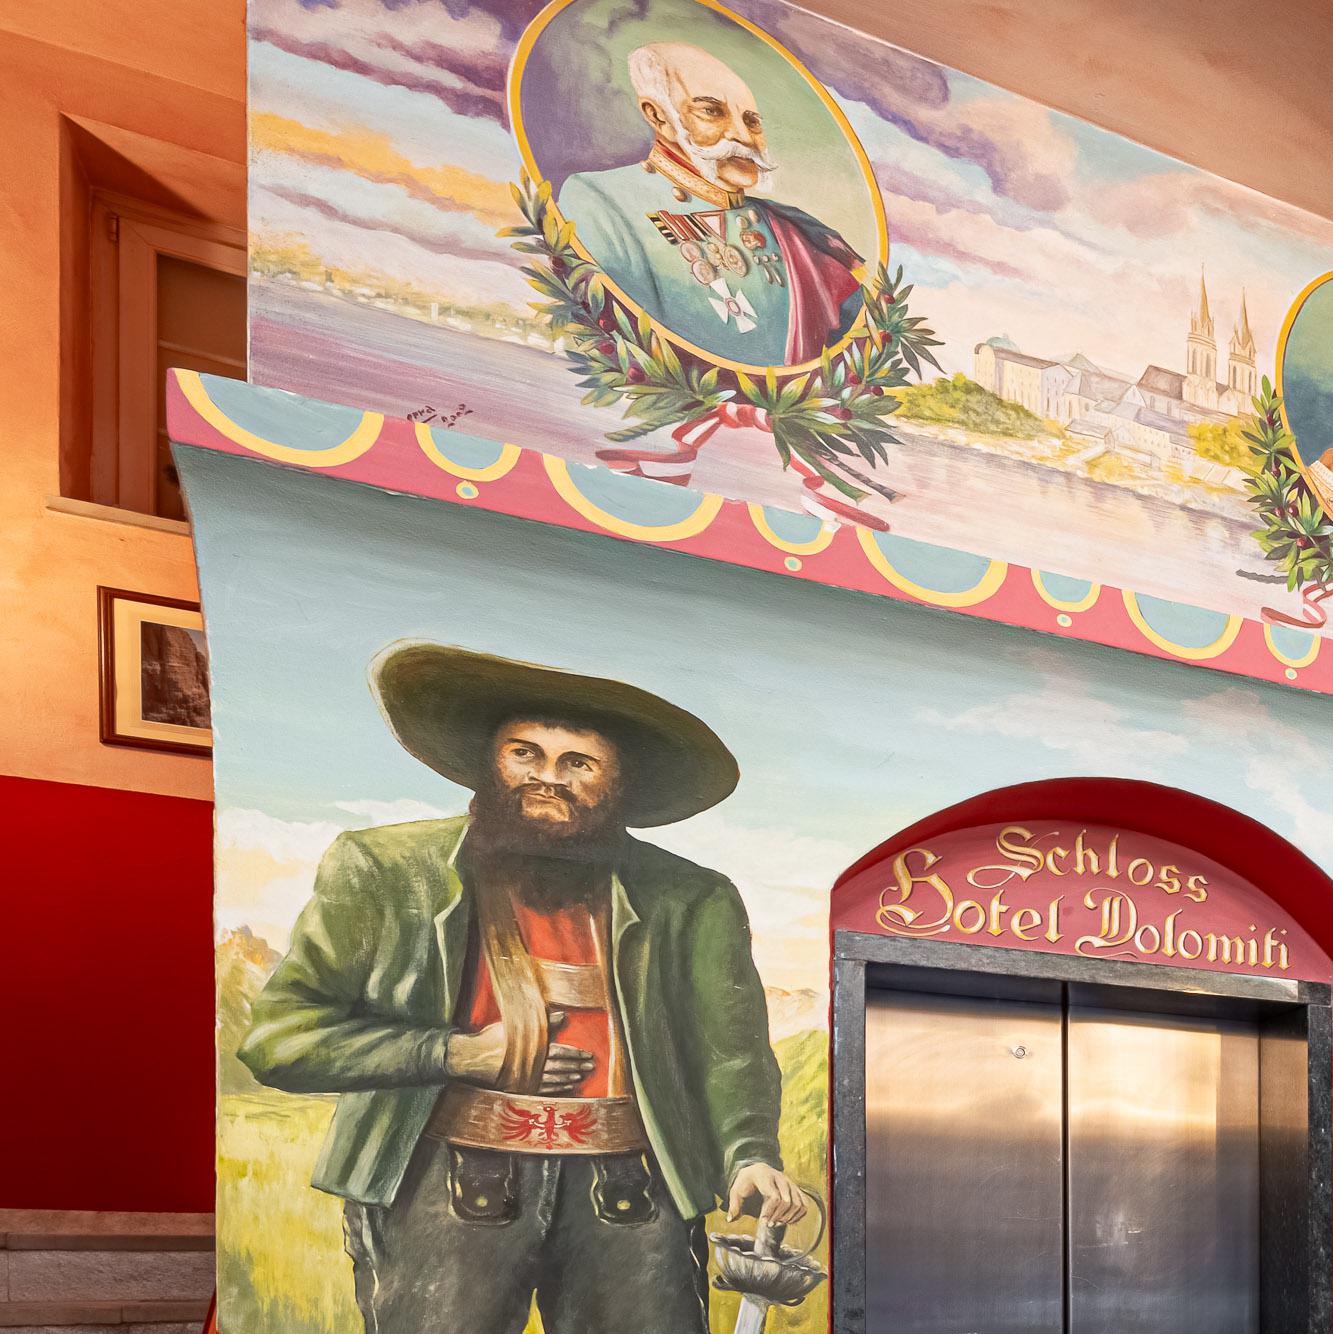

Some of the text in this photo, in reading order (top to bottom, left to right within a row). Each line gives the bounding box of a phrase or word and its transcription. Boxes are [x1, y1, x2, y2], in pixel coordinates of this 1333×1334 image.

[875, 848, 1292, 971] Hotel Dolomiti
[966, 825, 1209, 904] Schloss
